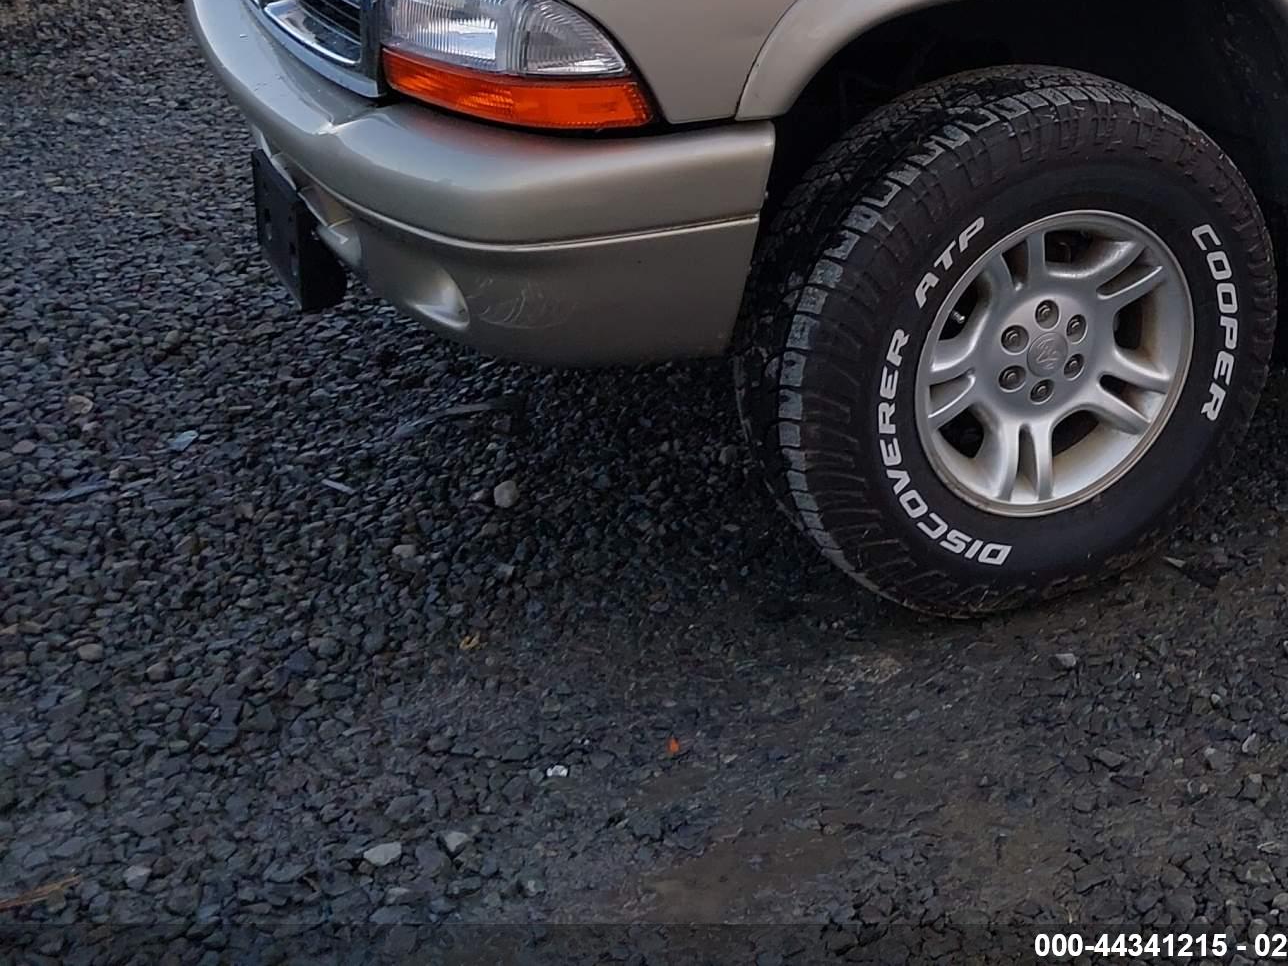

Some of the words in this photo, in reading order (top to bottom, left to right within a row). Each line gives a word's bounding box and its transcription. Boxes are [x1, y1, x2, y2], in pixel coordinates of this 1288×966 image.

[914, 216, 985, 309] ATP
[1191, 224, 1239, 421] COOPER
[878, 328, 1012, 565] DISCOVERER
